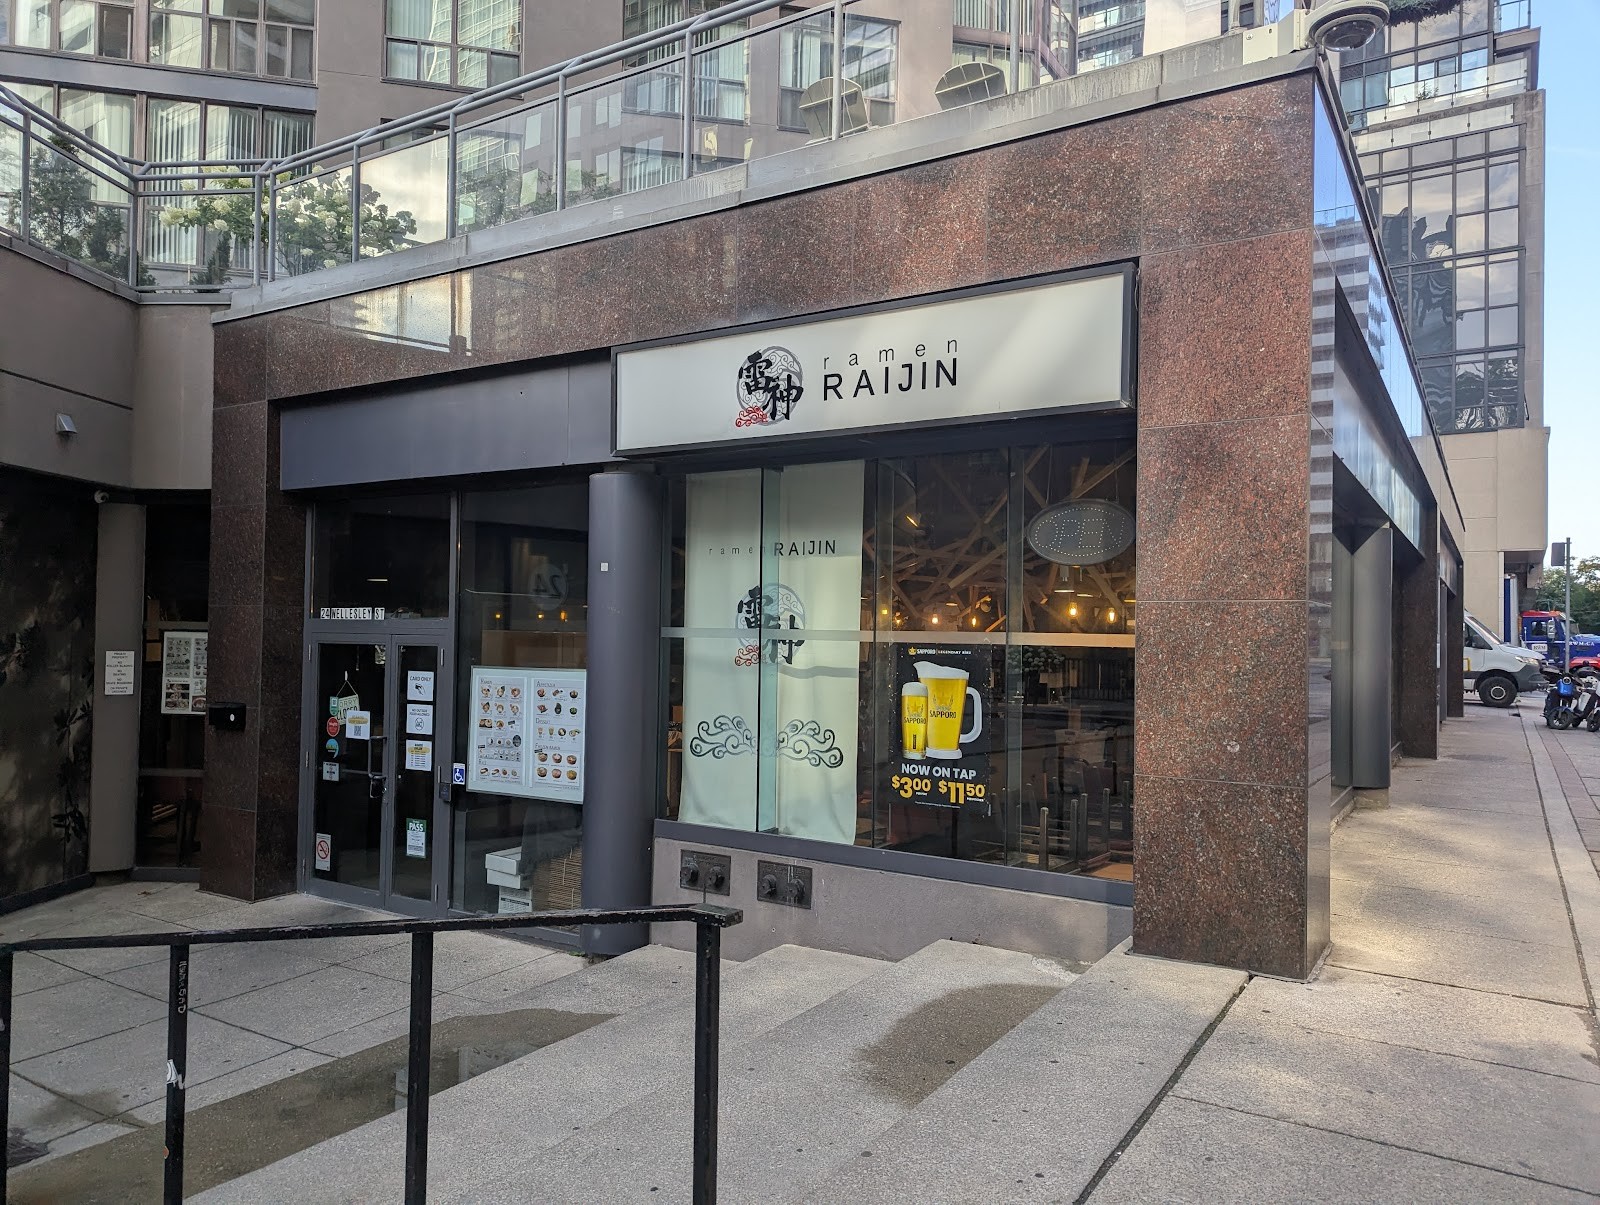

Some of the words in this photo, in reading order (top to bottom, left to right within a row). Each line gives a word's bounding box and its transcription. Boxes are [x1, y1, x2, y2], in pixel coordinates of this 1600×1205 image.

[823, 339, 958, 370] ramen
[738, 350, 804, 421] 雷神
[823, 357, 957, 402] RAIJIN
[1034, 517, 1125, 549] OPEN
[774, 539, 837, 557] RAIJIN
[321, 608, 330, 619] 24
[375, 608, 385, 619] ST
[903, 716, 927, 725] SAPPORO
[929, 709, 957, 719] SAPPORO
[901, 763, 931, 776] NOW
[932, 766, 950, 778] ON
[953, 768, 977, 780] TAP
[408, 822, 424, 832] PASS
